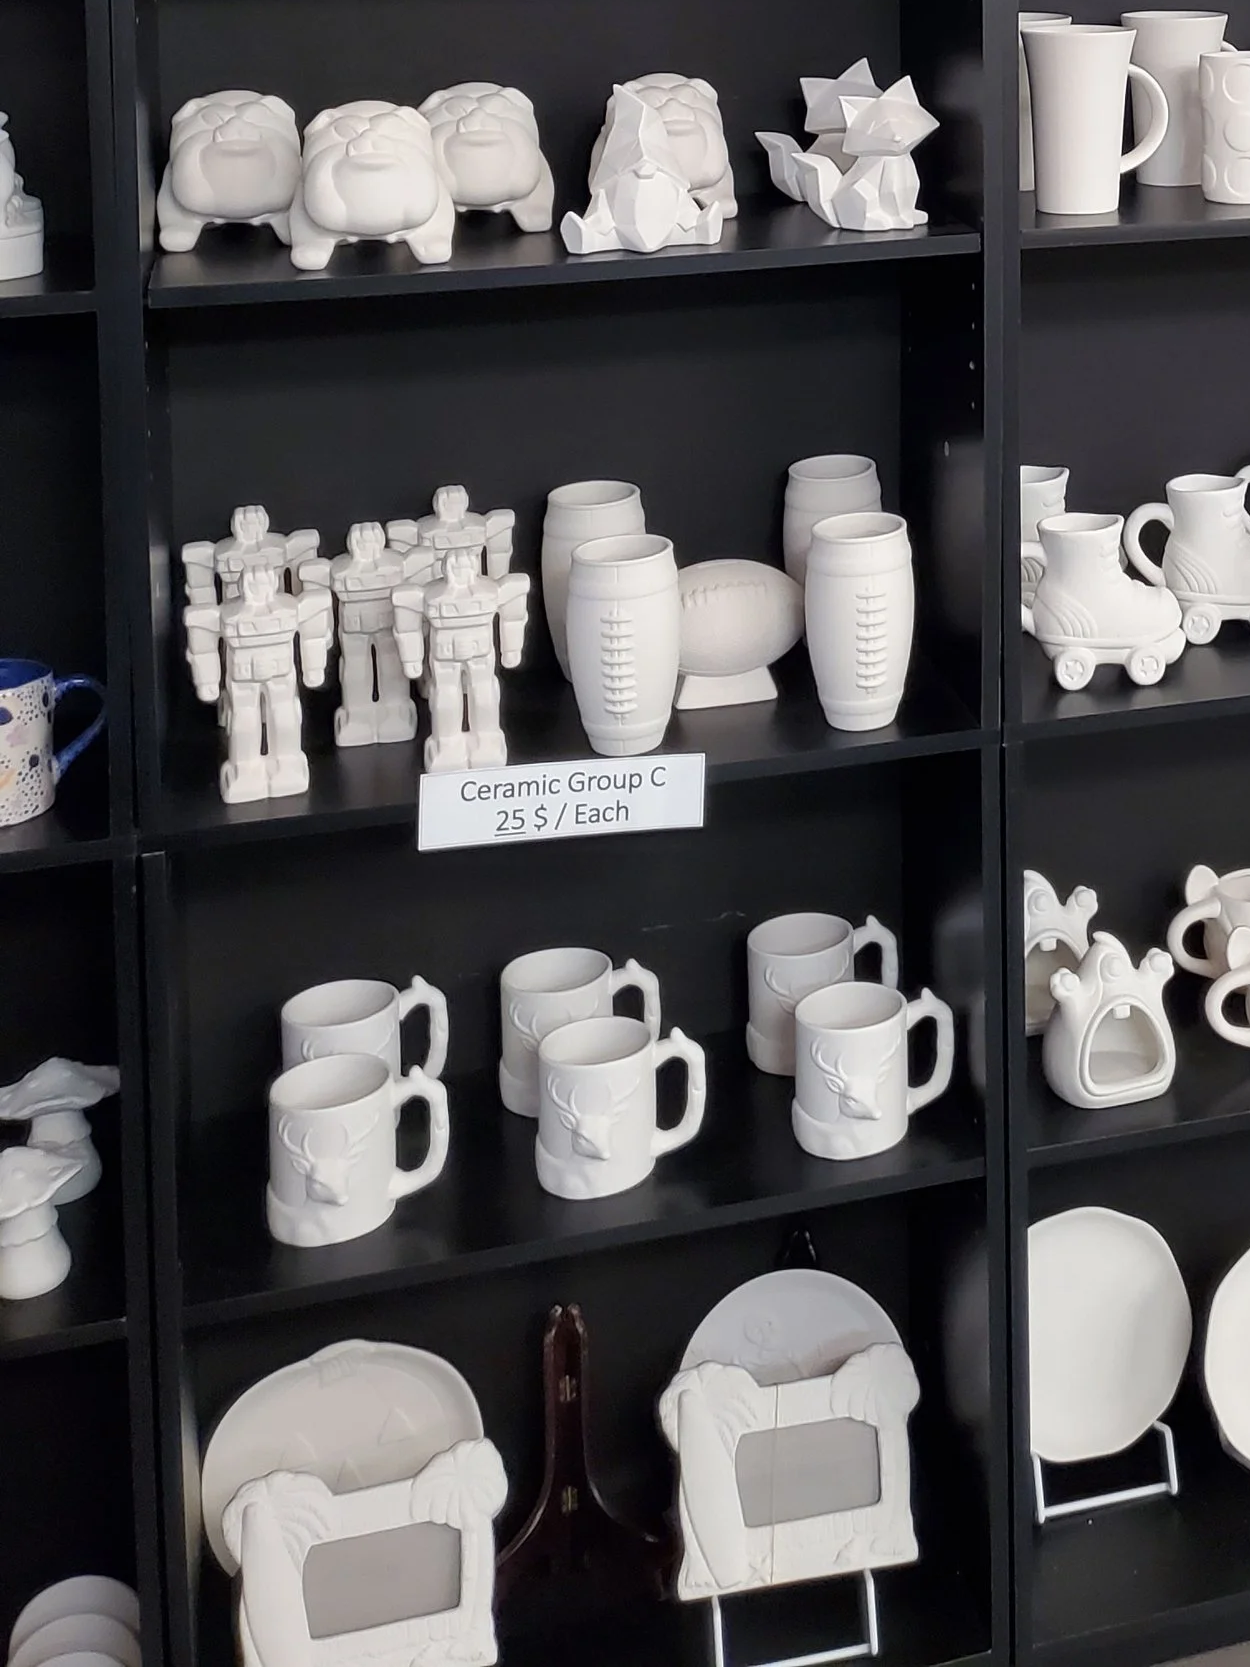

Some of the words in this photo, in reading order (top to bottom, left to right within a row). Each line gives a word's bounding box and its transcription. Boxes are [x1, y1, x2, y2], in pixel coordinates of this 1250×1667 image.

[460, 773, 561, 802] Ceramic
[567, 771, 643, 795] Group
[650, 766, 667, 787] C
[495, 808, 526, 836] 25
[533, 803, 549, 832] $
[554, 802, 568, 831] /
[575, 799, 630, 825] Each
